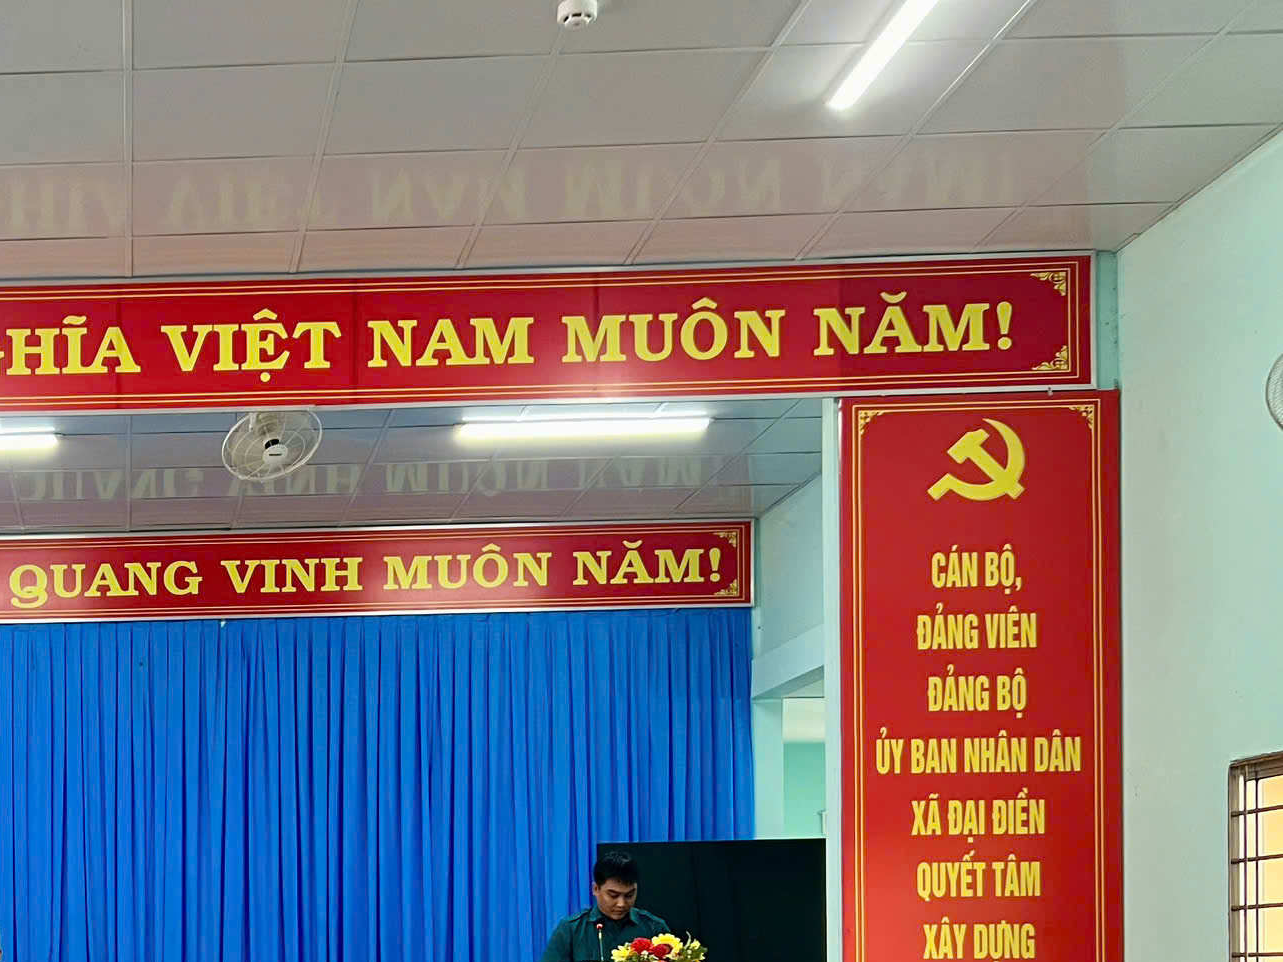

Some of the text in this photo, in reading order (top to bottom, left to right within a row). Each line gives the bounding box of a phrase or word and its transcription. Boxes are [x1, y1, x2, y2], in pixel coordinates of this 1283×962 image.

[161, 309, 341, 378] VIỆT
[368, 317, 534, 367] NAM
[562, 298, 785, 364] MUÔN
[814, 292, 1012, 355] NĂM!
[9, 561, 203, 611] QUANG
[221, 557, 363, 593] VINH
[384, 544, 552, 592] MUÔN
[573, 540, 720, 585] NĂM!
[932, 544, 1023, 594] CÁN BỘ,
[917, 603, 1036, 650] ĐẢNG VIÊN
[928, 664, 1026, 718] ĐẢNG BỘ
[876, 727, 1080, 774] ỦY BAN NHÂN DÂN
[911, 788, 1045, 843] XÃ ĐẠI ĐIỀN
[917, 850, 1040, 902] QUYẾT TÂM
[923, 916, 967, 959] XÂY
